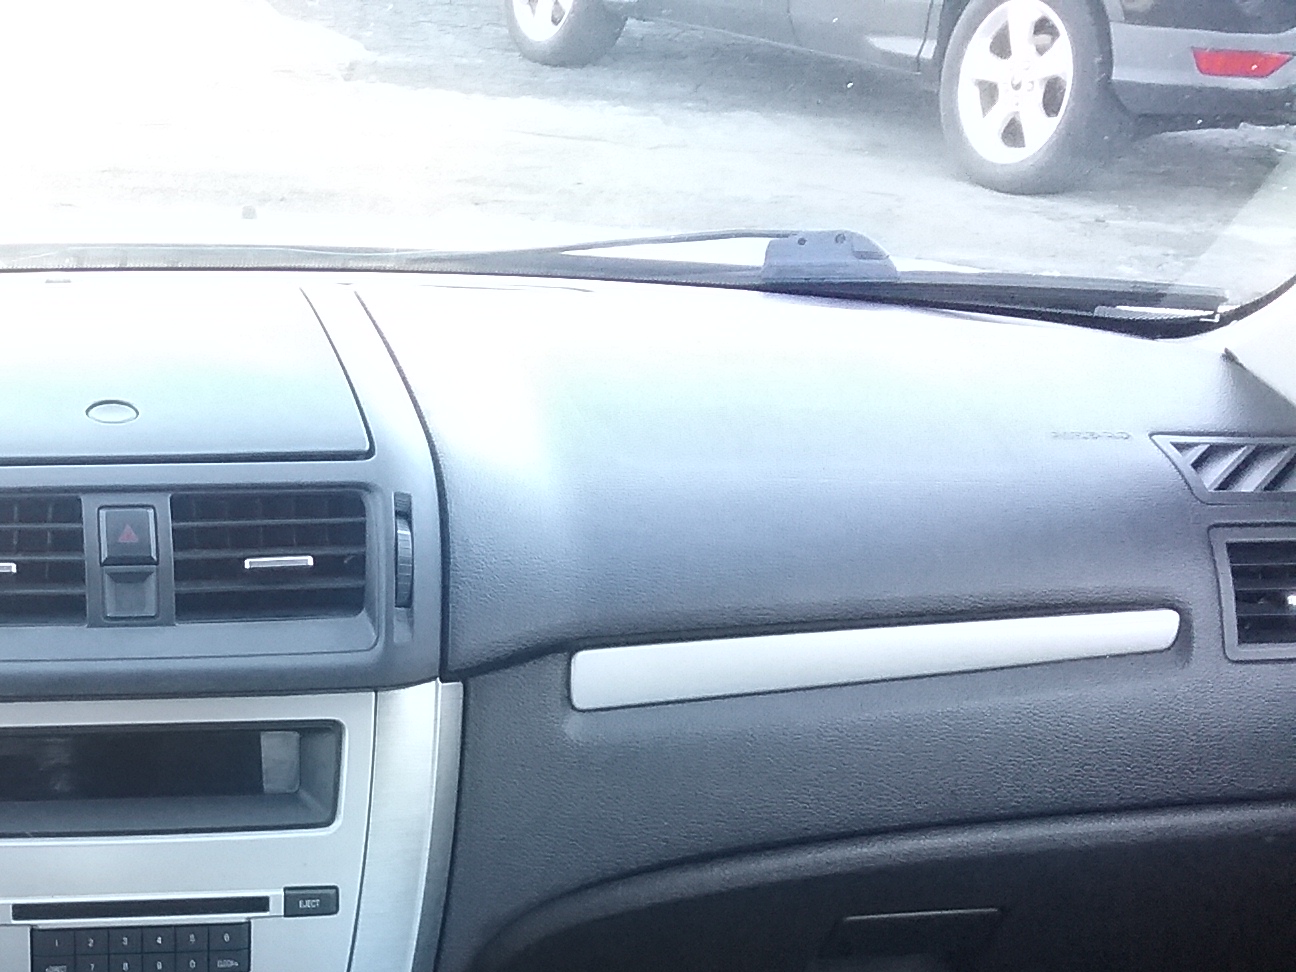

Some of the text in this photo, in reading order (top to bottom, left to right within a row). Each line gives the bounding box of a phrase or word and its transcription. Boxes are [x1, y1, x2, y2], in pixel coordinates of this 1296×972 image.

[298, 898, 322, 909] EJECT
[54, 939, 60, 948] 1
[87, 937, 95, 948] 2
[121, 936, 129, 947] 3
[156, 935, 163, 945] 4
[88, 963, 96, 972] 7
